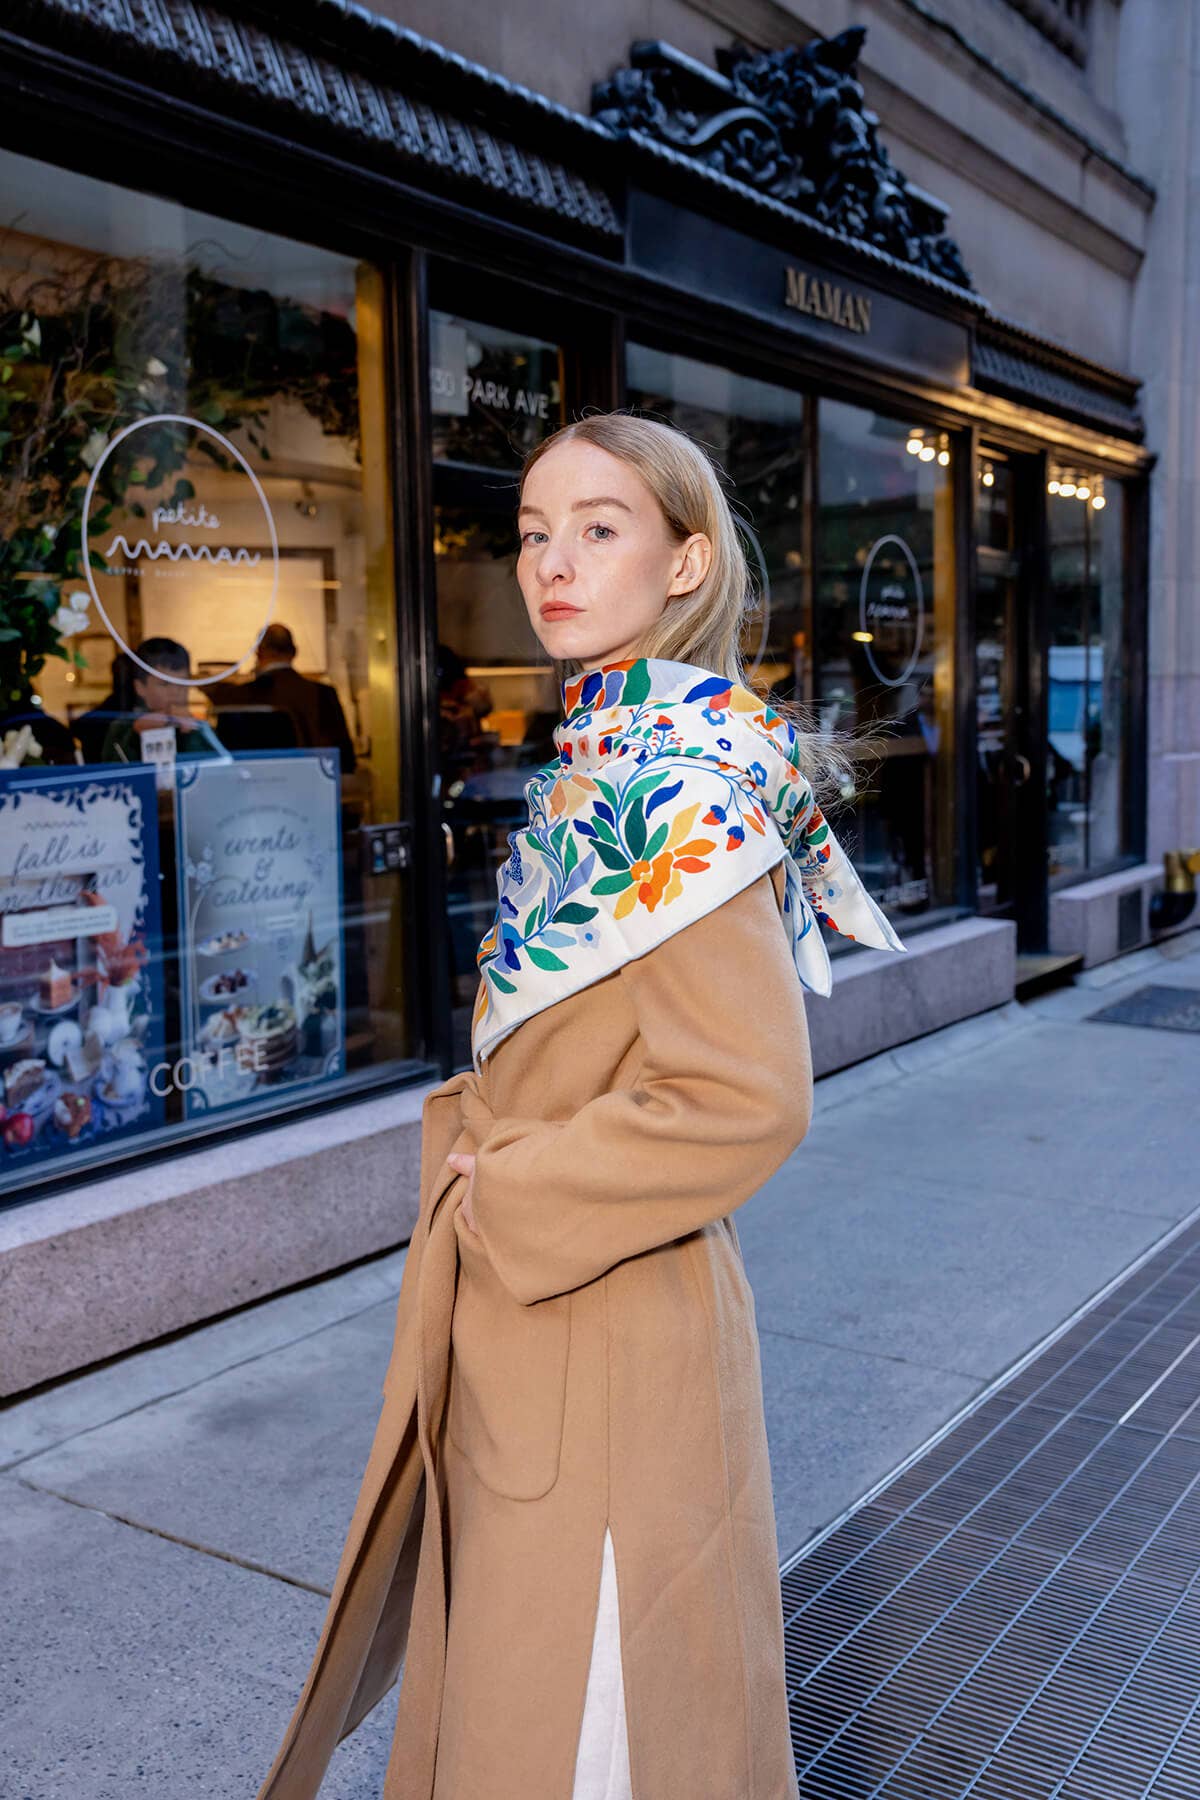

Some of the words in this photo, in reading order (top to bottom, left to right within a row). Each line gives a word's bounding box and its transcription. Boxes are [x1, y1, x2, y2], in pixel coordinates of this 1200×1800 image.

[785, 266, 872, 333] MAMAN
[462, 376, 511, 411] PARK
[514, 388, 550, 420] AVE
[152, 502, 221, 532] petite
[11, 835, 72, 887] fall
[75, 834, 106, 858] is
[223, 826, 303, 856] events
[212, 875, 313, 911] catering
[150, 1038, 270, 1097] COFFEE
